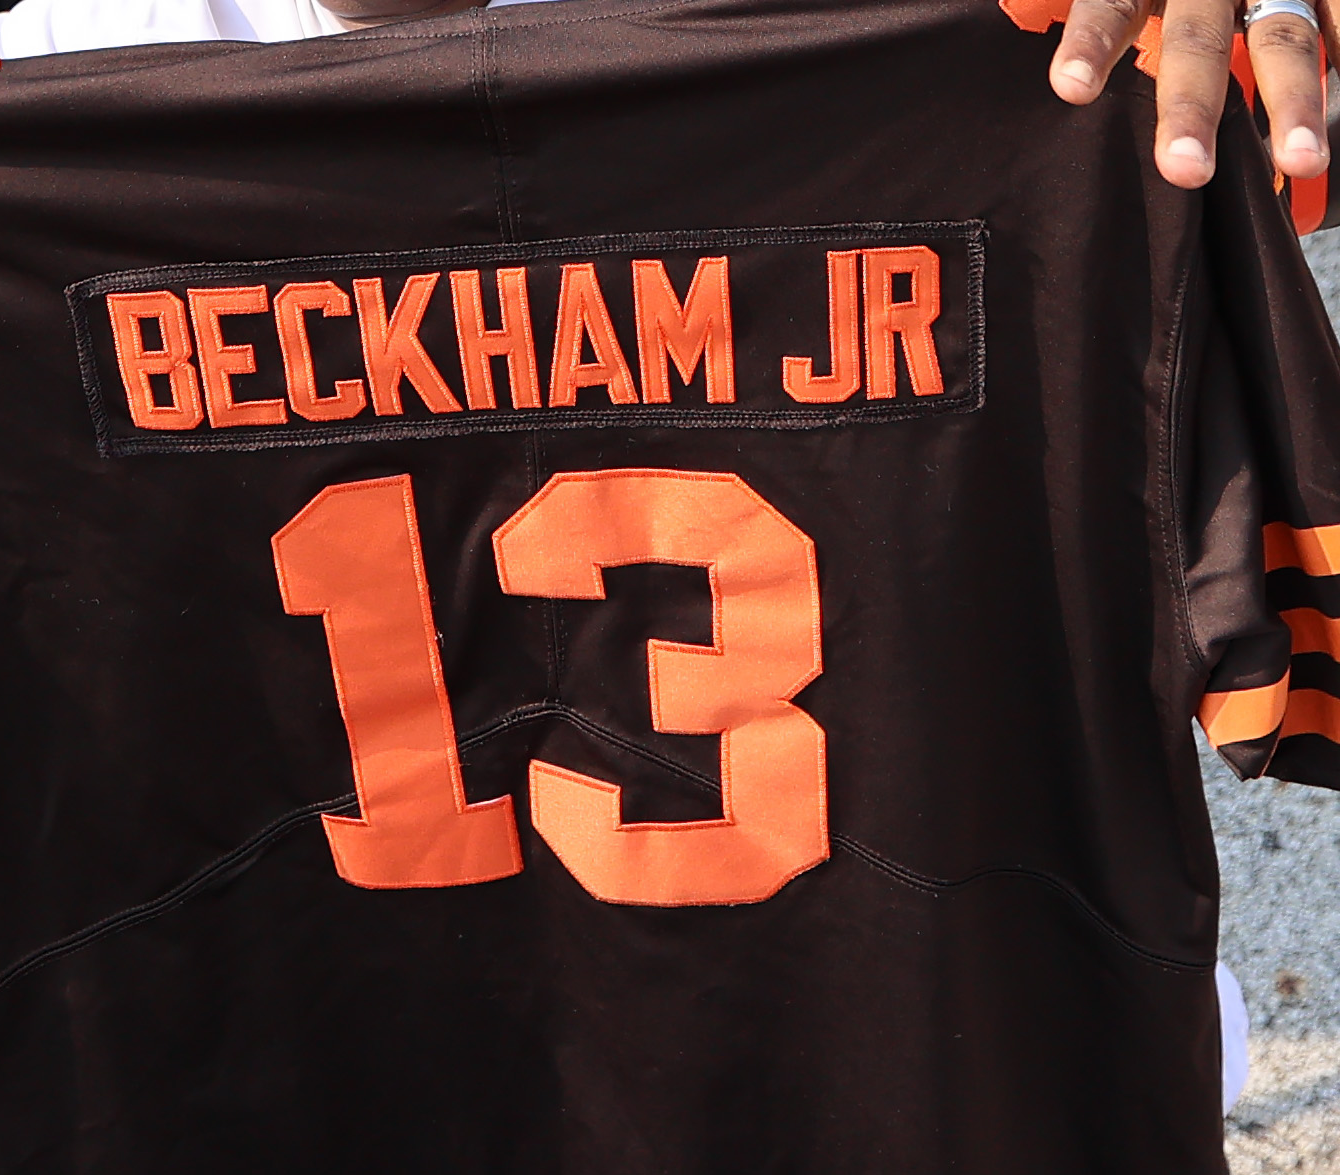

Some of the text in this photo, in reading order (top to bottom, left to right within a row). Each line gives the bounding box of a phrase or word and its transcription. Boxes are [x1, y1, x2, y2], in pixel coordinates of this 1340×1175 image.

[106, 245, 945, 431] BECKHAM JR
[270, 467, 831, 908] 13
